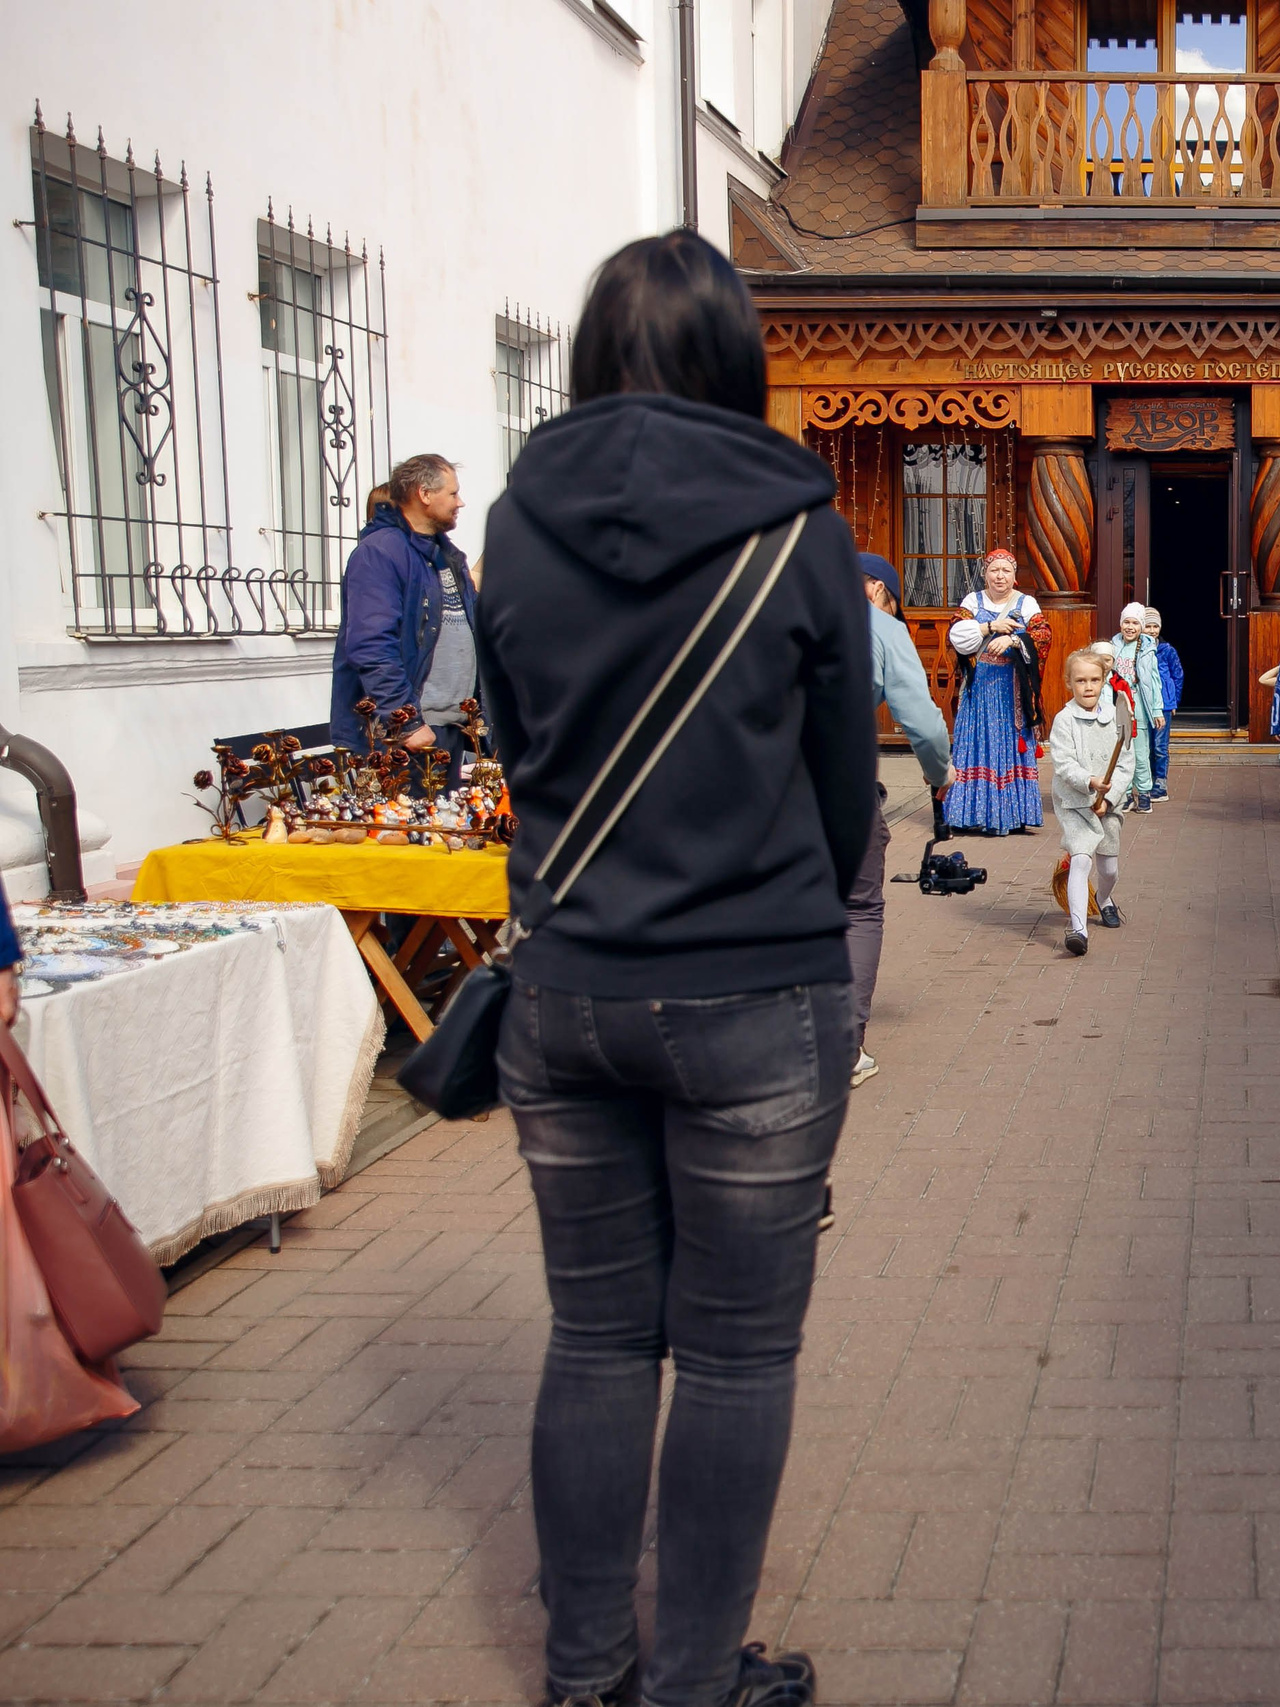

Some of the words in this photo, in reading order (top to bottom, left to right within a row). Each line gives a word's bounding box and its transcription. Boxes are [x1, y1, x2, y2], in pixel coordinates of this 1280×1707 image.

[964, 361, 1093, 382] НАСТОЯЩЕЕ
[1103, 362, 1196, 382] РУССКОЕ
[1121, 410, 1220, 445] ДВОР
